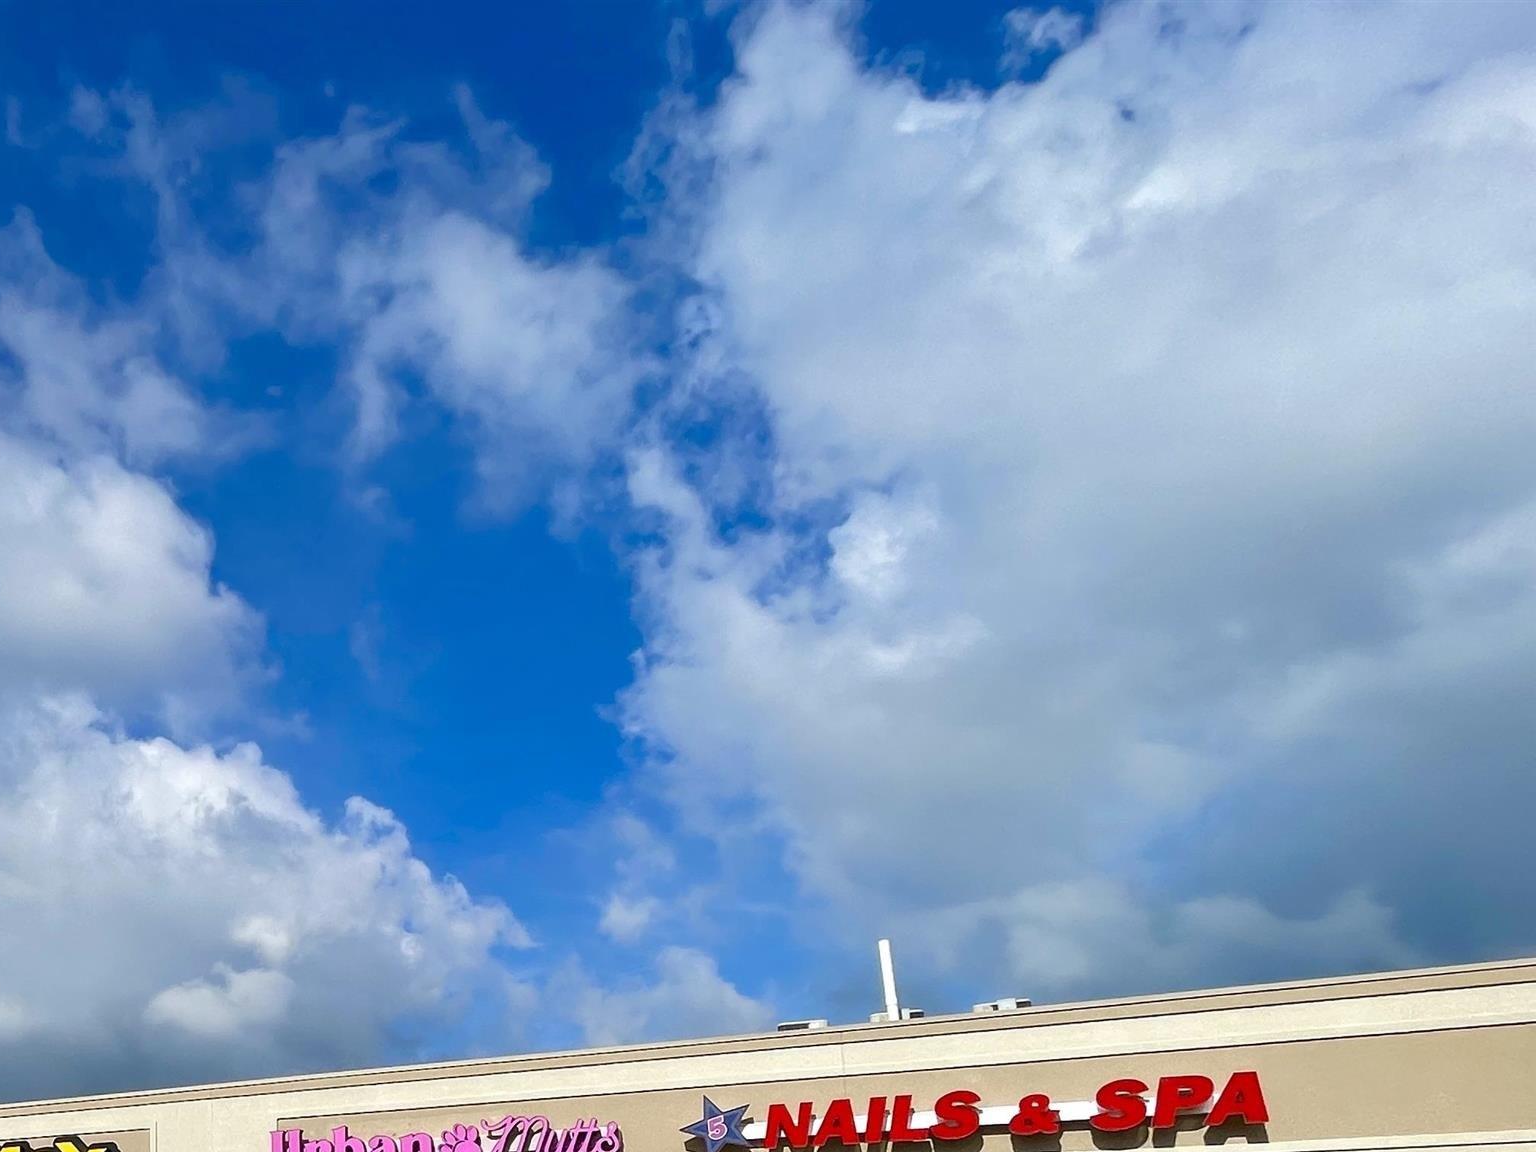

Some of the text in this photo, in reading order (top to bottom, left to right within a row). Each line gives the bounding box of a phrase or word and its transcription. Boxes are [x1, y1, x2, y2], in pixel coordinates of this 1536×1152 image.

[707, 1071, 1269, 1149] 5 NAILS & SPA
